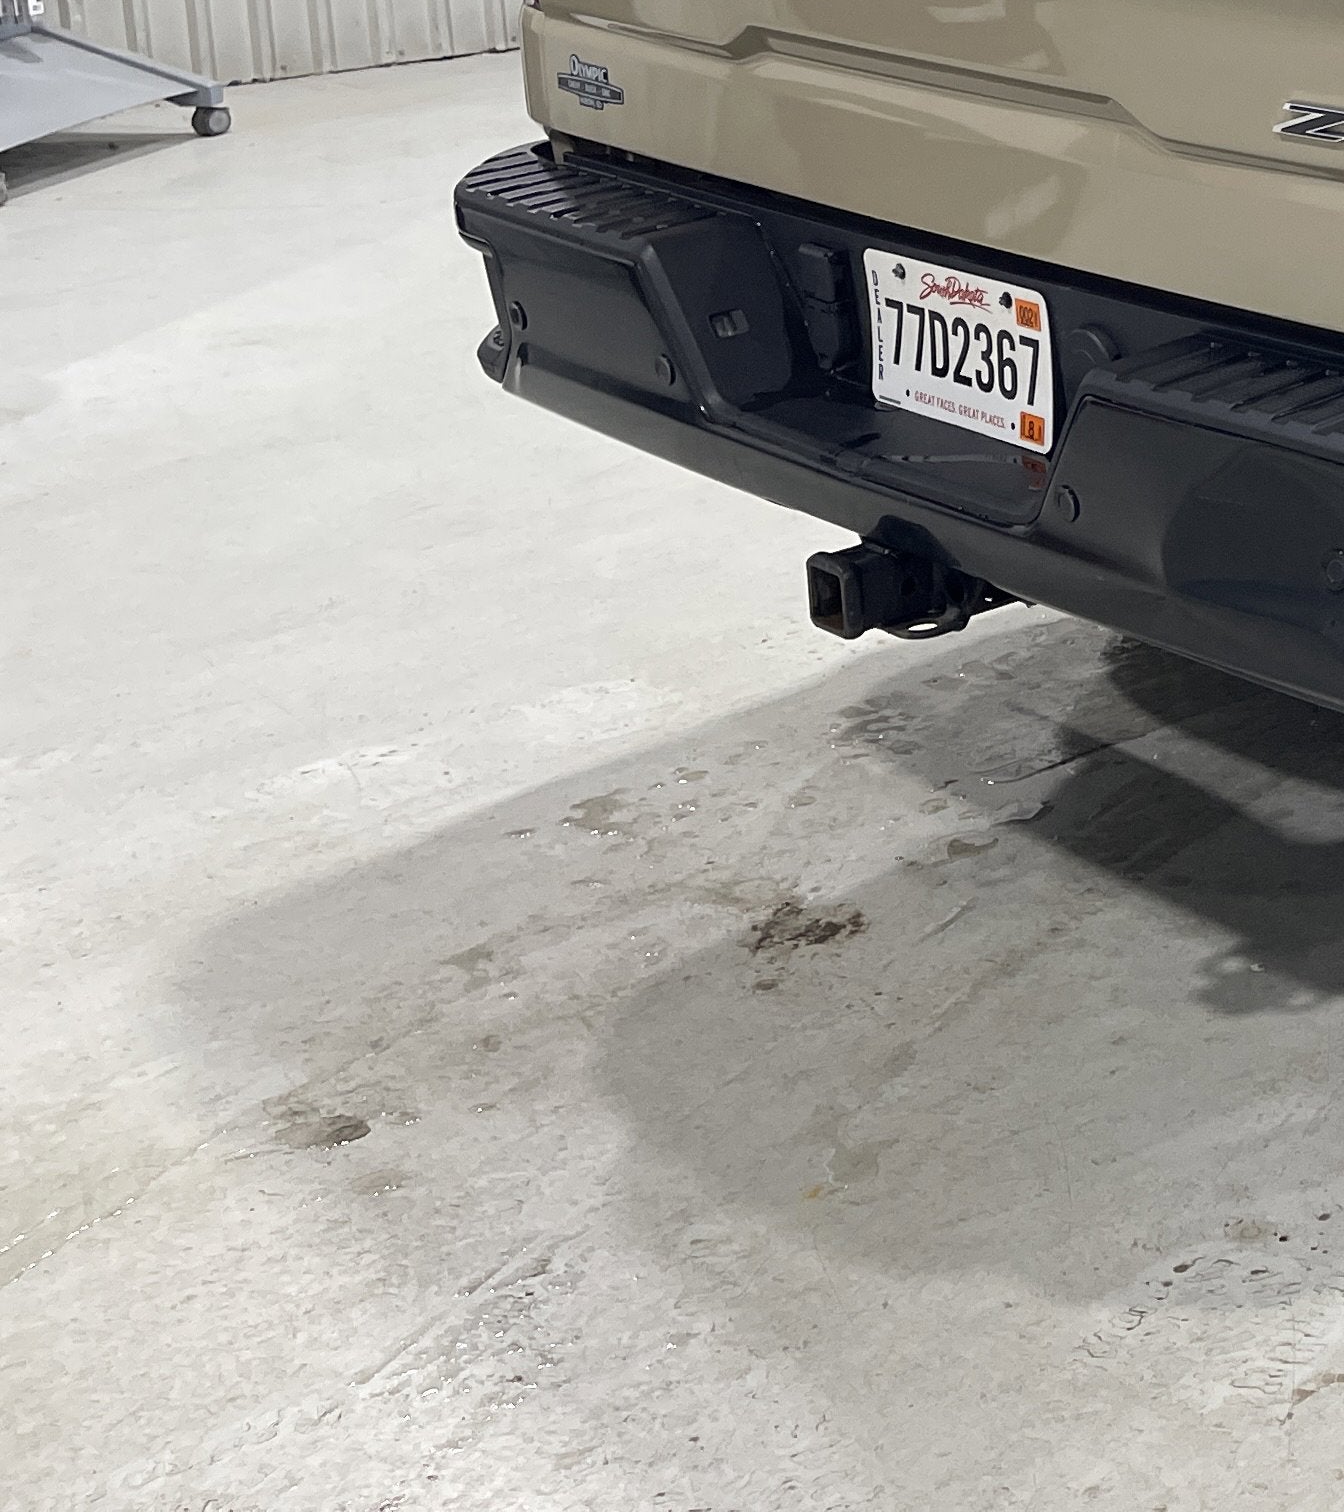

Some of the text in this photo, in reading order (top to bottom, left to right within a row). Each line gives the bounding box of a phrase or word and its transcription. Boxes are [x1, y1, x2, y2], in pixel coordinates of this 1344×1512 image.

[885, 297, 1040, 407] 77D2367
[914, 390, 935, 407] GREAT
[958, 404, 980, 420] GREAT
